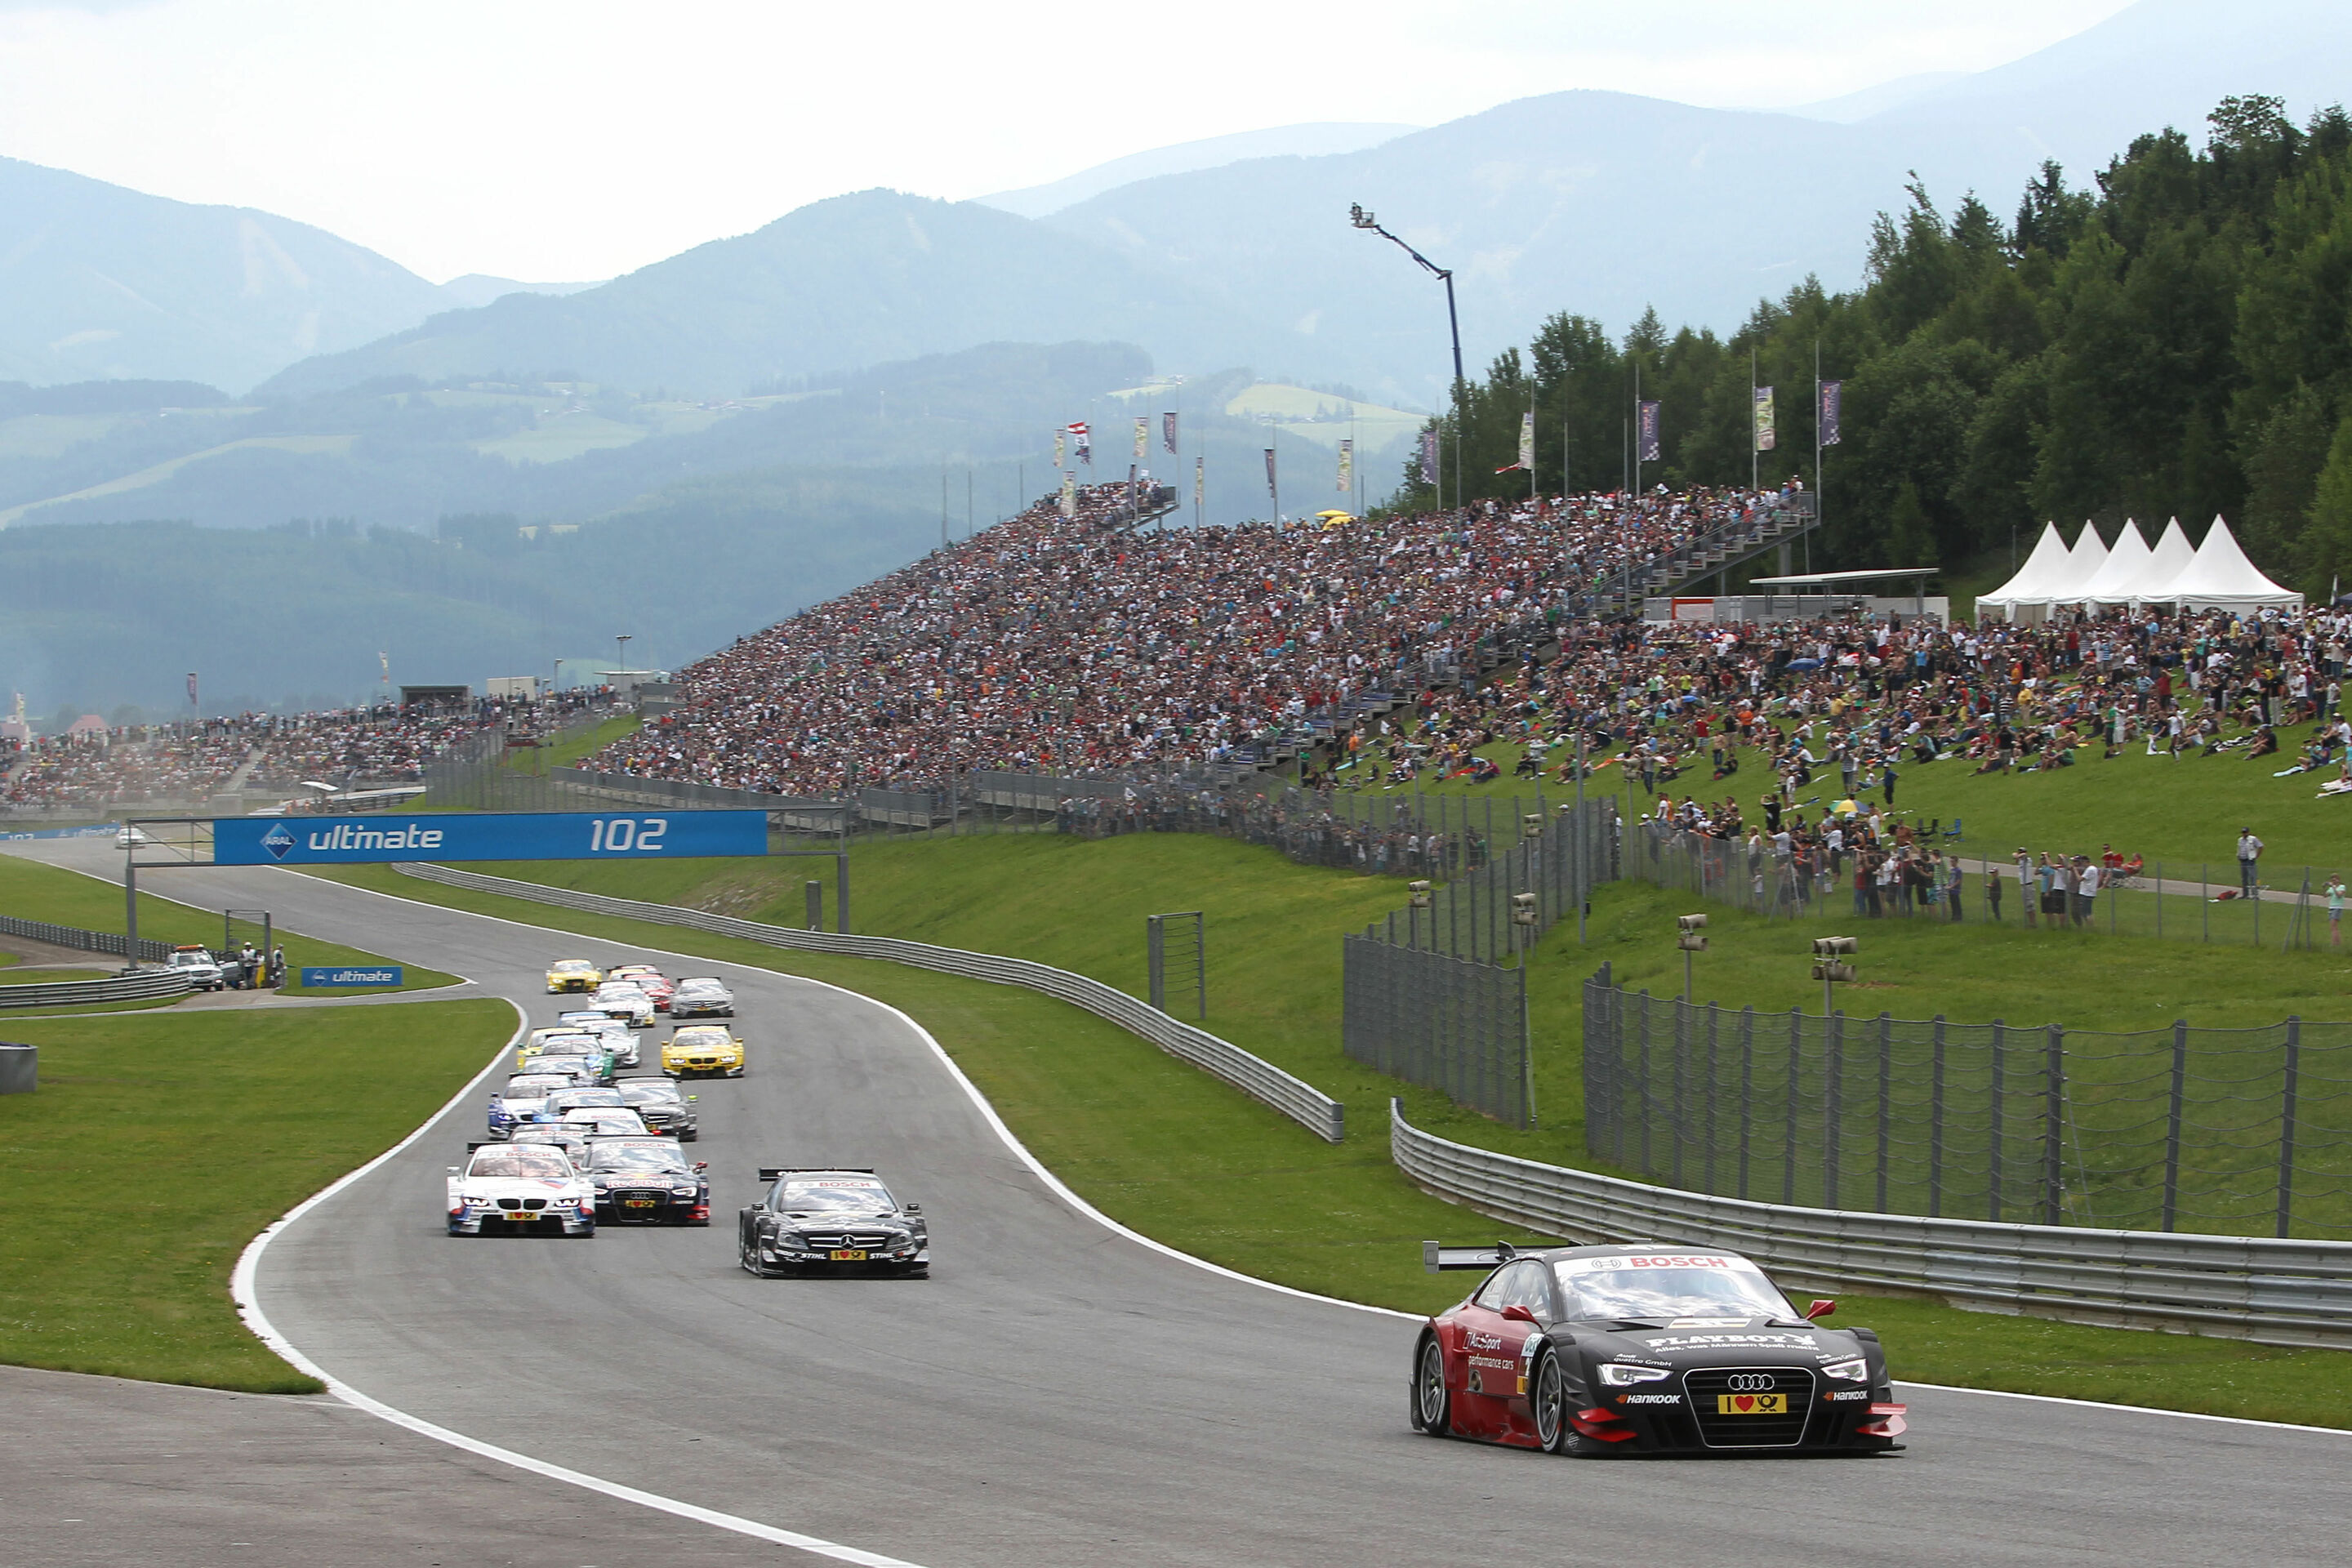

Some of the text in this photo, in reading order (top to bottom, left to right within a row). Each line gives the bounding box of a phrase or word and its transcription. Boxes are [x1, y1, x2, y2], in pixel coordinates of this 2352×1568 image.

[265, 818, 668, 852] ARAL ultimate 102
[332, 970, 394, 982] ultimate
[1630, 1257, 1729, 1268] BOSCH
[1645, 1334, 1787, 1348] PLAYBOY
[1502, 1359, 1514, 1370] cars
